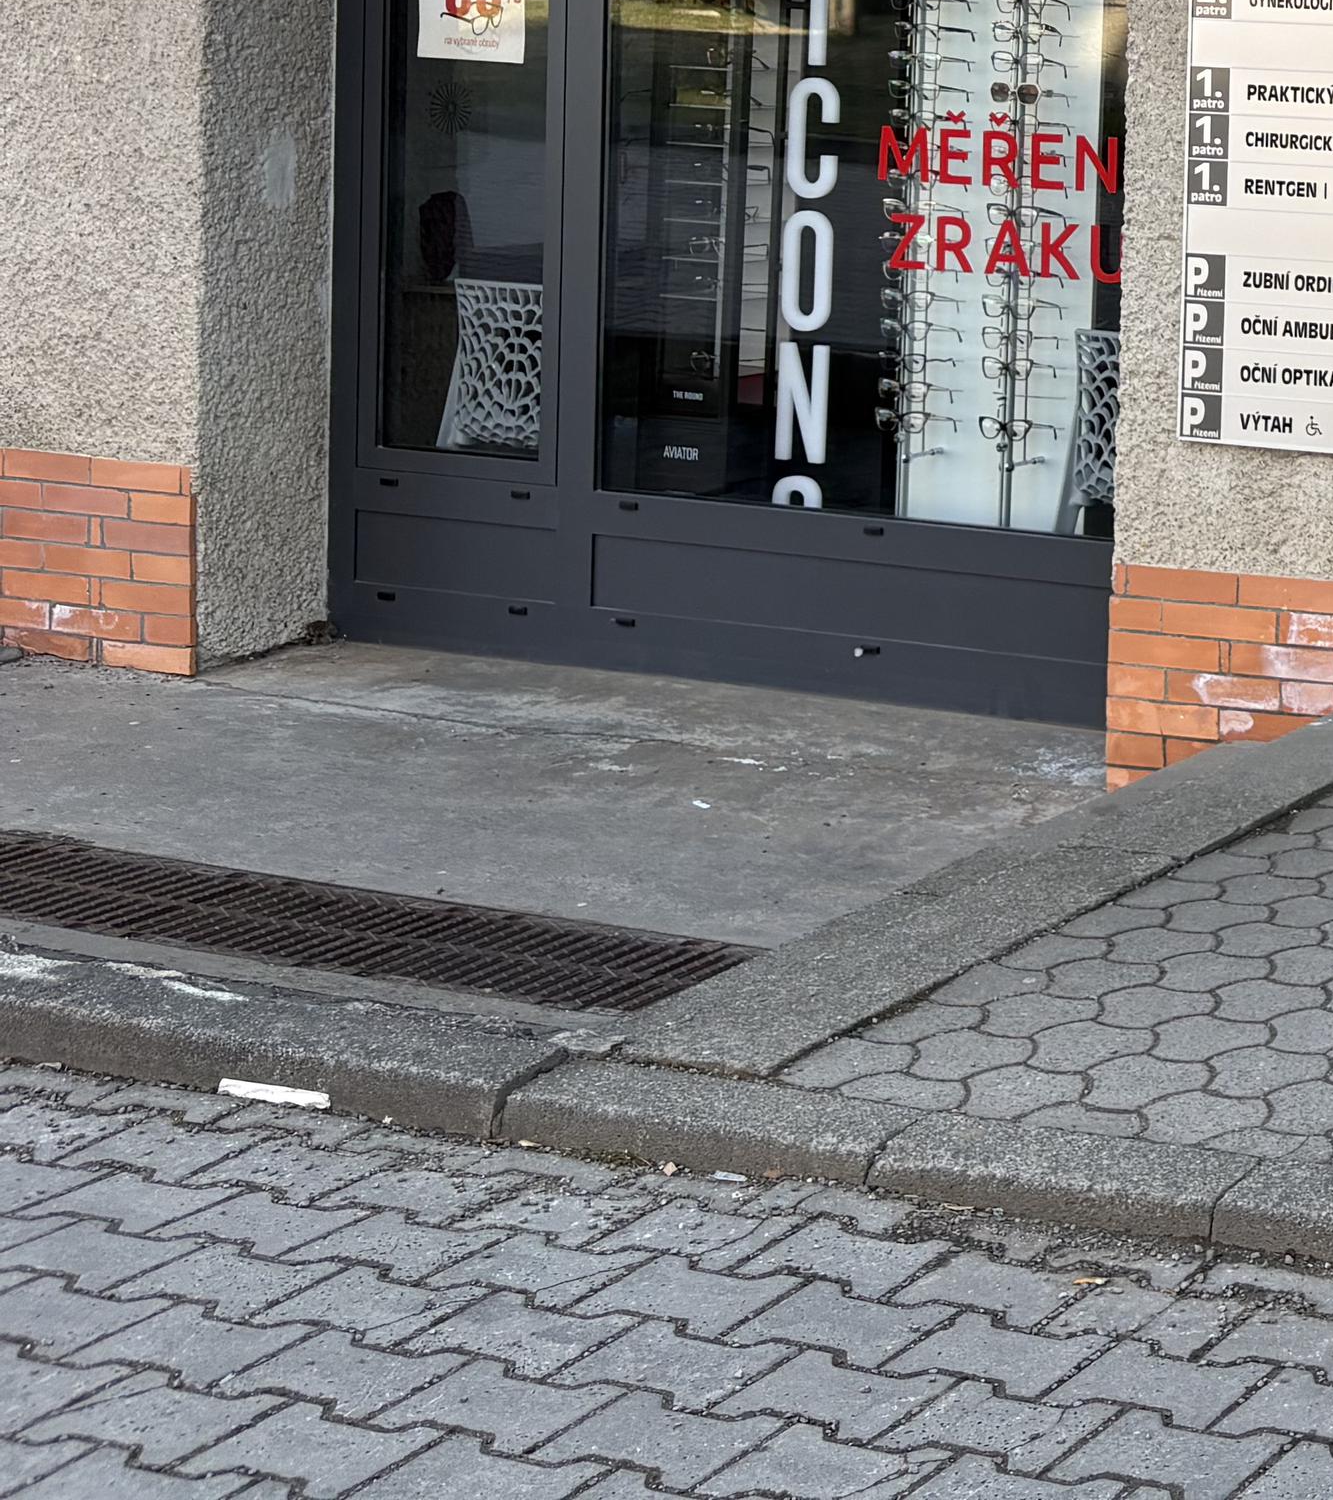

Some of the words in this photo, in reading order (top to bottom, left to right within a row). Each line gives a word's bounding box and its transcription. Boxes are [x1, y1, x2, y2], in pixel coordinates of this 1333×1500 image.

[1196, 5, 1227, 16] patro
[1196, 68, 1222, 98] 1.
[1192, 98, 1224, 109] patro
[1196, 116, 1222, 144] 1.
[1192, 145, 1224, 156] patro
[1194, 162, 1220, 192] 1.
[1191, 192, 1222, 202] patro
[1244, 178, 1316, 198] RENTGEN
[889, 212, 1124, 284] ZRAKU
[1243, 271, 1291, 290] ZUBNÍ
[1241, 315, 1278, 336] OČNÍ
[1240, 363, 1278, 384] OČNÍ
[1240, 412, 1292, 434] VÝTAH
[663, 445, 699, 460] AVIATOR
